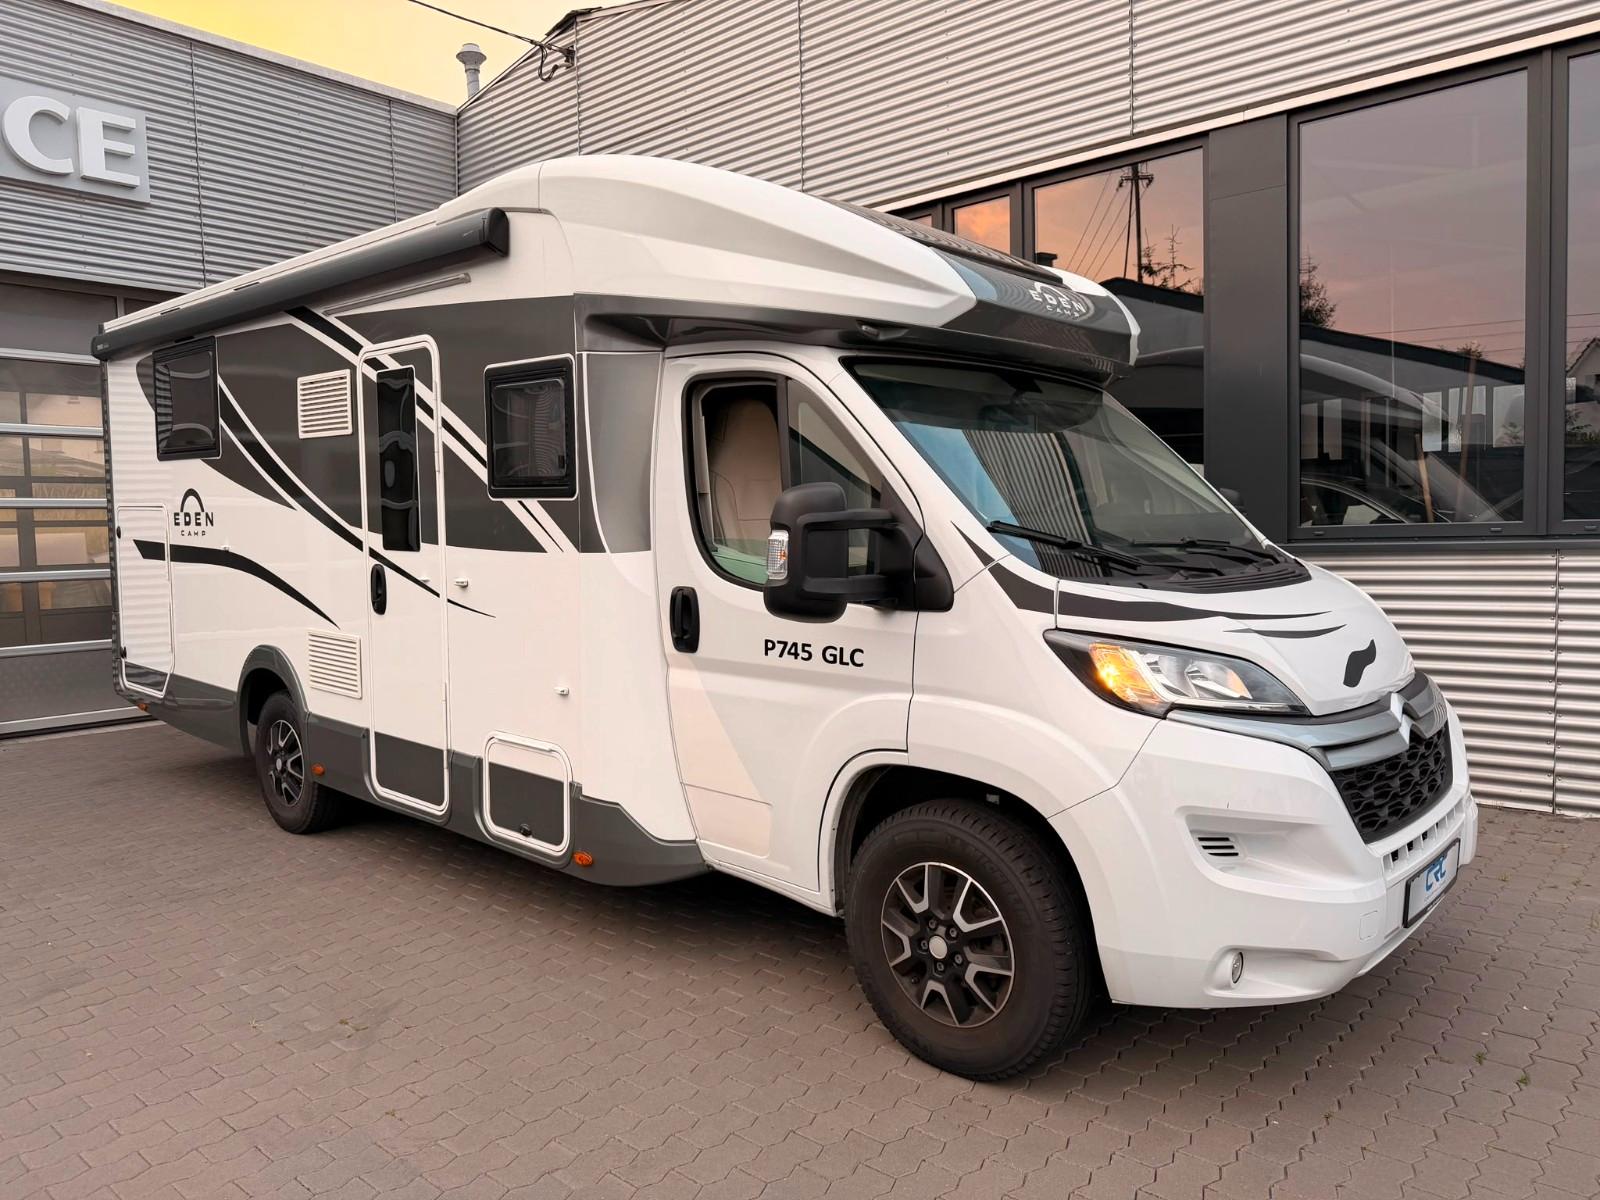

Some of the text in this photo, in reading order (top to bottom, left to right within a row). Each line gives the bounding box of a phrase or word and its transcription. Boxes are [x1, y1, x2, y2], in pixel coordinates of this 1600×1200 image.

[1029, 289, 1086, 313] EDEN
[173, 511, 214, 527] EDEN
[764, 639, 864, 668] P745 GLC
